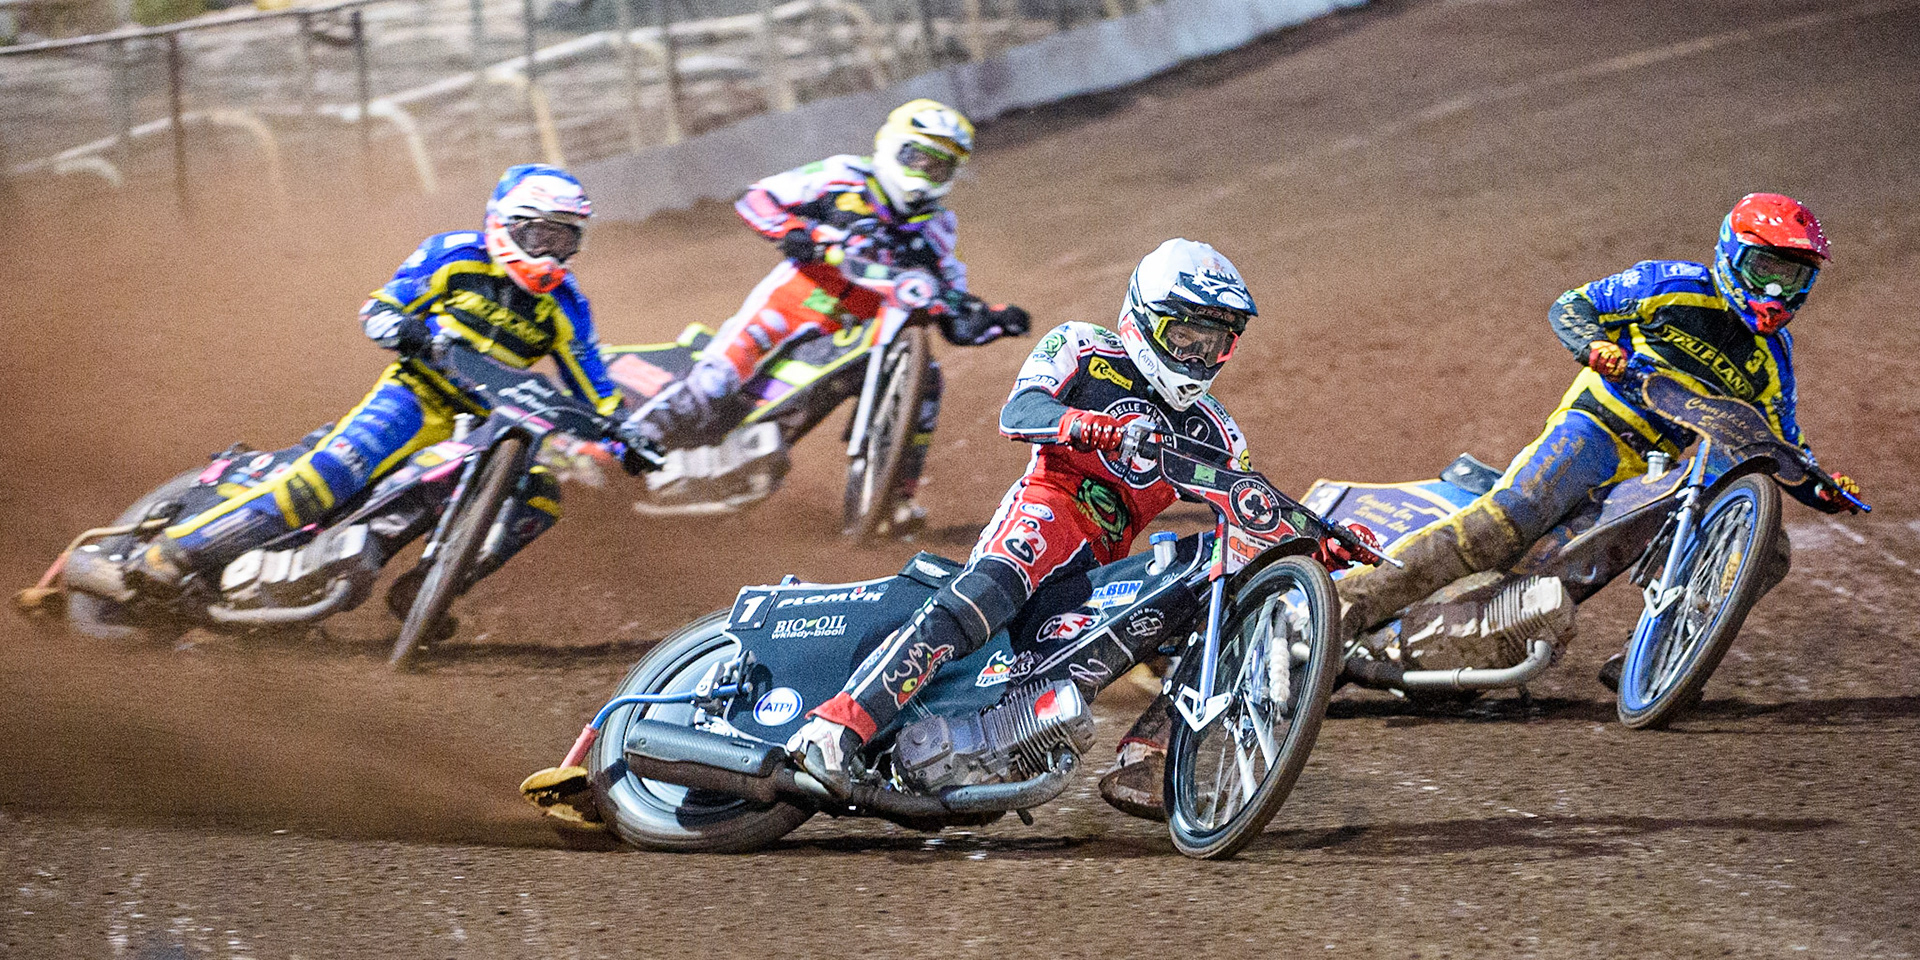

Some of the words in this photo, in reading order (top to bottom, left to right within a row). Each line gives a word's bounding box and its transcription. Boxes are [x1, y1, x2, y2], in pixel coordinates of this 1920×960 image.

[1745, 349, 1766, 374] 3
[1109, 402, 1141, 419] BELLE
[1234, 481, 1250, 494] BELLE
[738, 595, 767, 623] 1
[762, 700, 793, 713] ATPI
